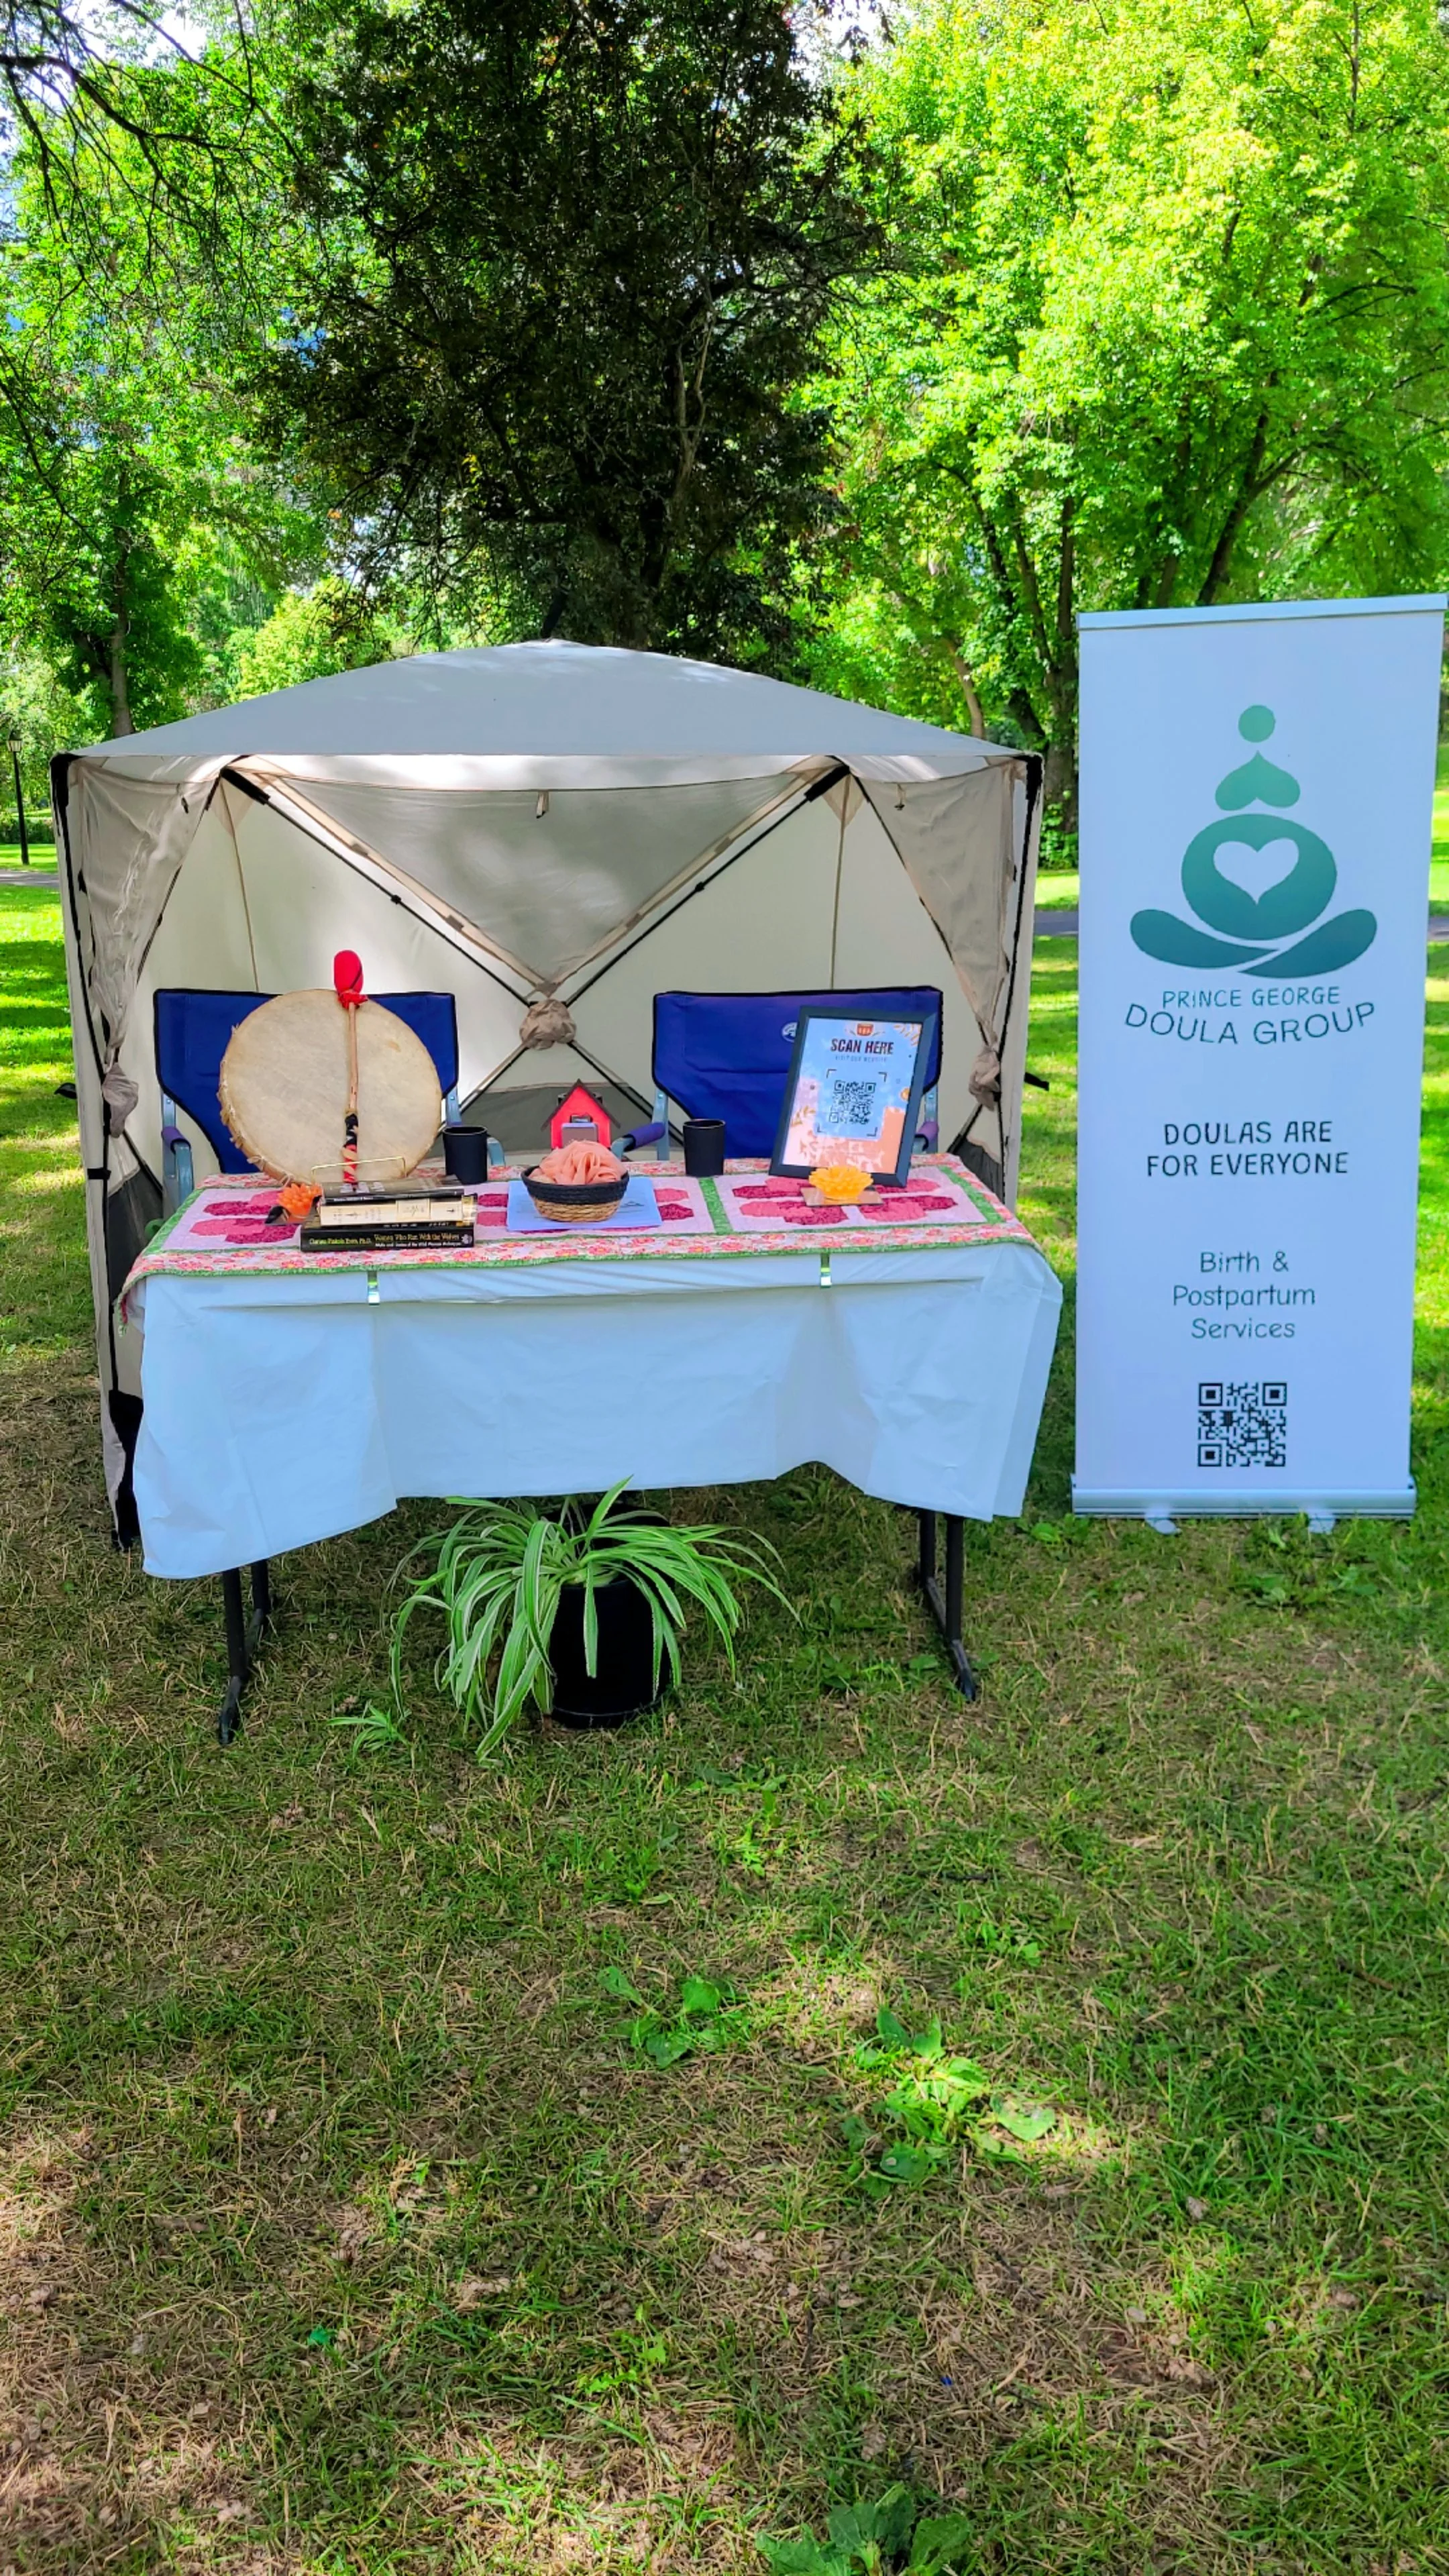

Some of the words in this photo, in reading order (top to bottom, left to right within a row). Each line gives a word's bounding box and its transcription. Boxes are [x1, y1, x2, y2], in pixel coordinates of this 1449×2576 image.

[1163, 989, 1242, 1009] PRINCE
[1251, 985, 1340, 1007] GEORGE
[1124, 1003, 1238, 1044] DOULA
[1252, 1002, 1375, 1045] GROUP
[830, 1038, 862, 1053] SCAN
[865, 1040, 894, 1055] HERE
[1163, 1120, 1272, 1146] DOULAS
[1283, 1120, 1333, 1144] ARE
[1146, 1154, 1199, 1177] FOR
[1210, 1151, 1349, 1176] EVERYONE
[1200, 1251, 1260, 1273] Birth
[1273, 1250, 1289, 1273] &
[1173, 1284, 1316, 1311] Postpartum
[1191, 1317, 1295, 1339] Services
